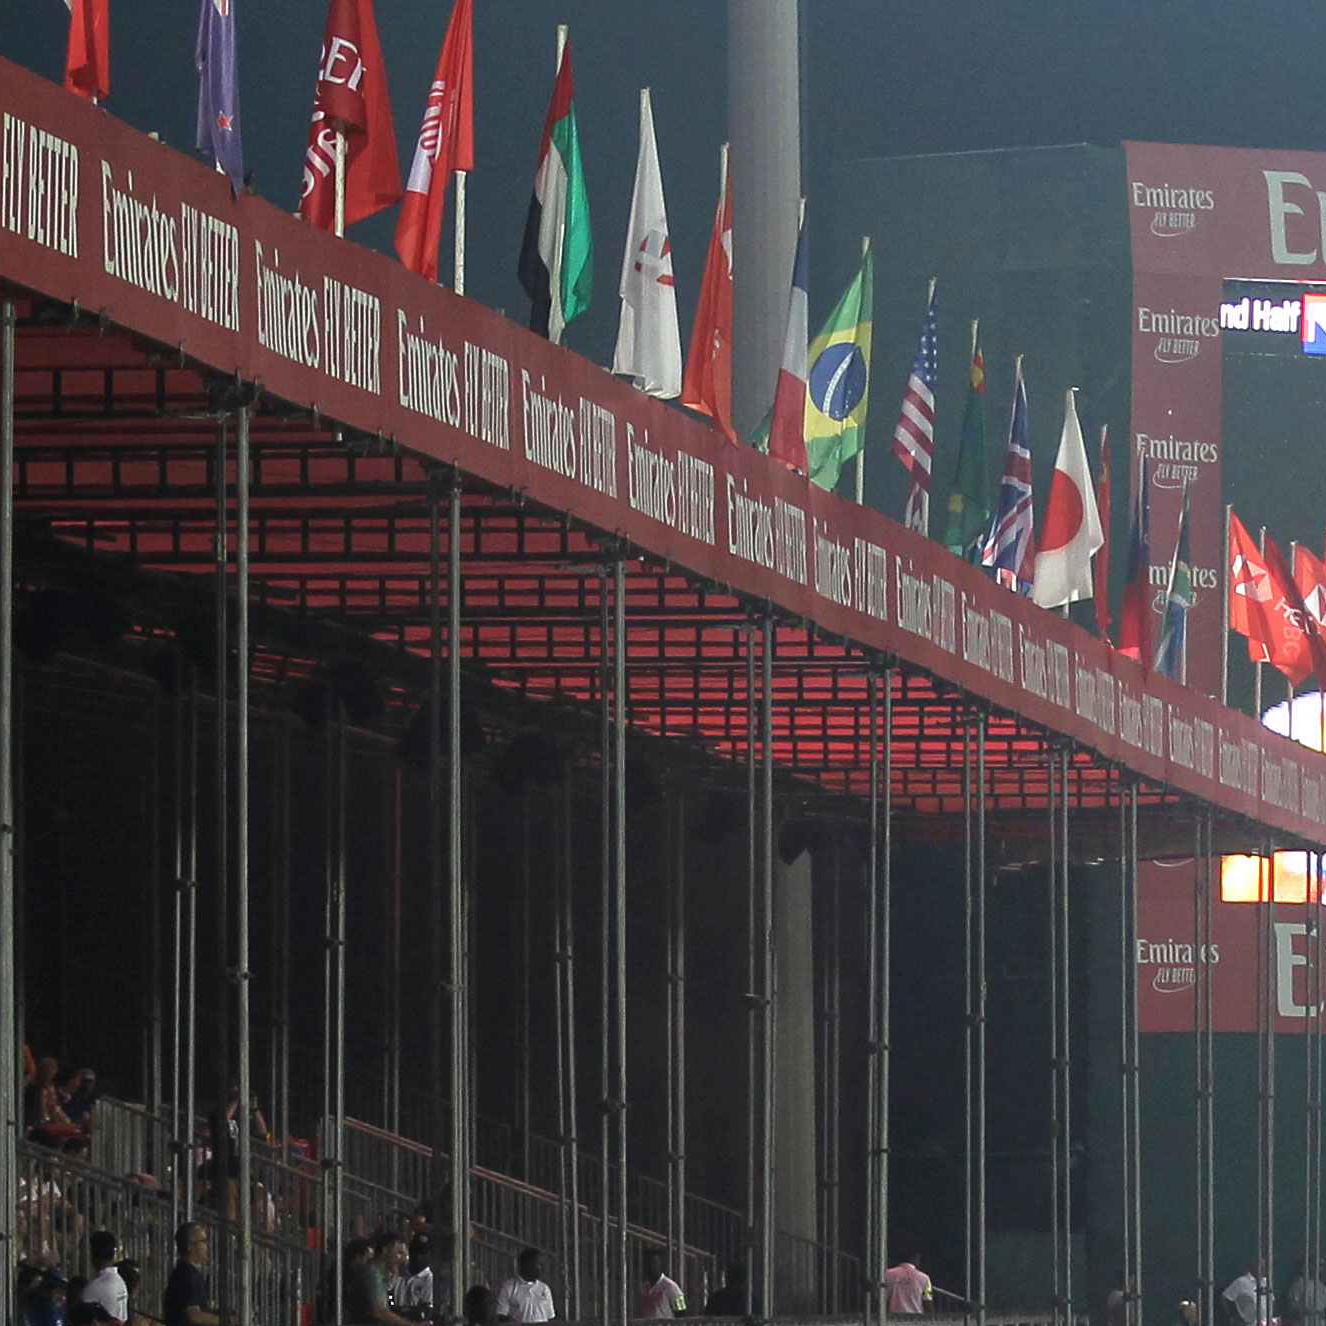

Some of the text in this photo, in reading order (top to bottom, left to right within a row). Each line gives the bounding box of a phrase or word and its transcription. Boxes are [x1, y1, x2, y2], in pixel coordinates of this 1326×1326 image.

[2, 112, 25, 234] FLY
[28, 126, 79, 258] BETTER
[1132, 181, 1214, 210] Emirates
[101, 159, 178, 302] Emirates
[182, 202, 198, 313] FLY
[200, 212, 240, 331] BETTER
[255, 239, 320, 368] Emirates
[1138, 307, 1220, 337] Emirates
[1253, 300, 1301, 333] Half
[397, 308, 461, 428] Emirates
[522, 368, 575, 479] Emirates
[1136, 433, 1218, 463] Emirates
